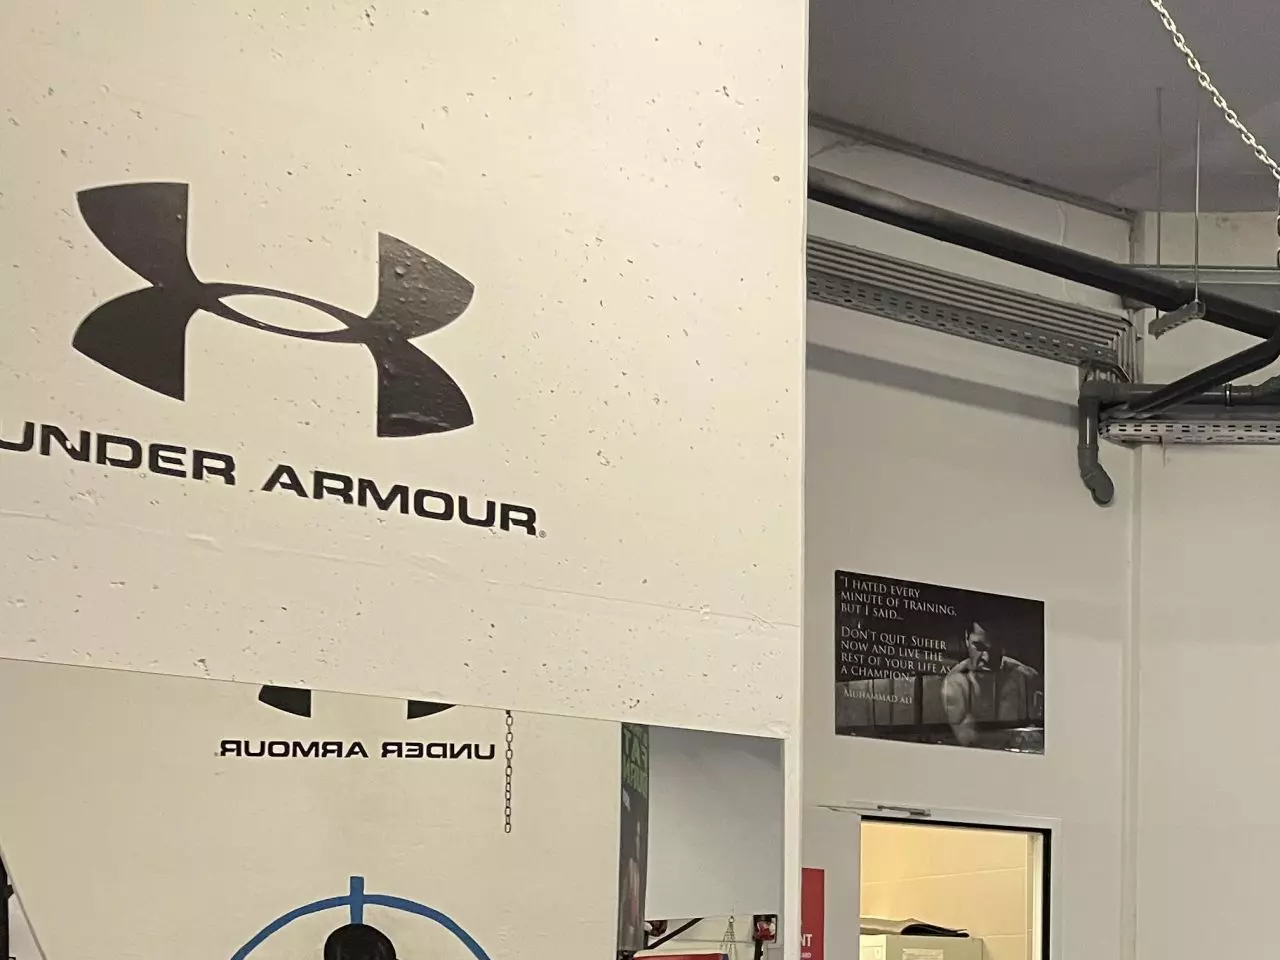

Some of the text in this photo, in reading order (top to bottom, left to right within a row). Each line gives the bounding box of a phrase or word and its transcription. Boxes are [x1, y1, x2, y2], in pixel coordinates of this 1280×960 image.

[0, 421, 538, 536] UNDER ARMOUR
[852, 579, 887, 594] HATED
[890, 585, 920, 599] EVERY
[841, 591, 883, 605] MINUTE
[886, 597, 900, 608] OF
[841, 602, 862, 614] BUT
[841, 640, 942, 662] NOW AND LIVE THE
[911, 635, 947, 651] SUFFER
[840, 665, 848, 674] A
[841, 652, 952, 674] REST OF YOUR LIFE AS
[843, 687, 897, 703] MUHAMMAD
